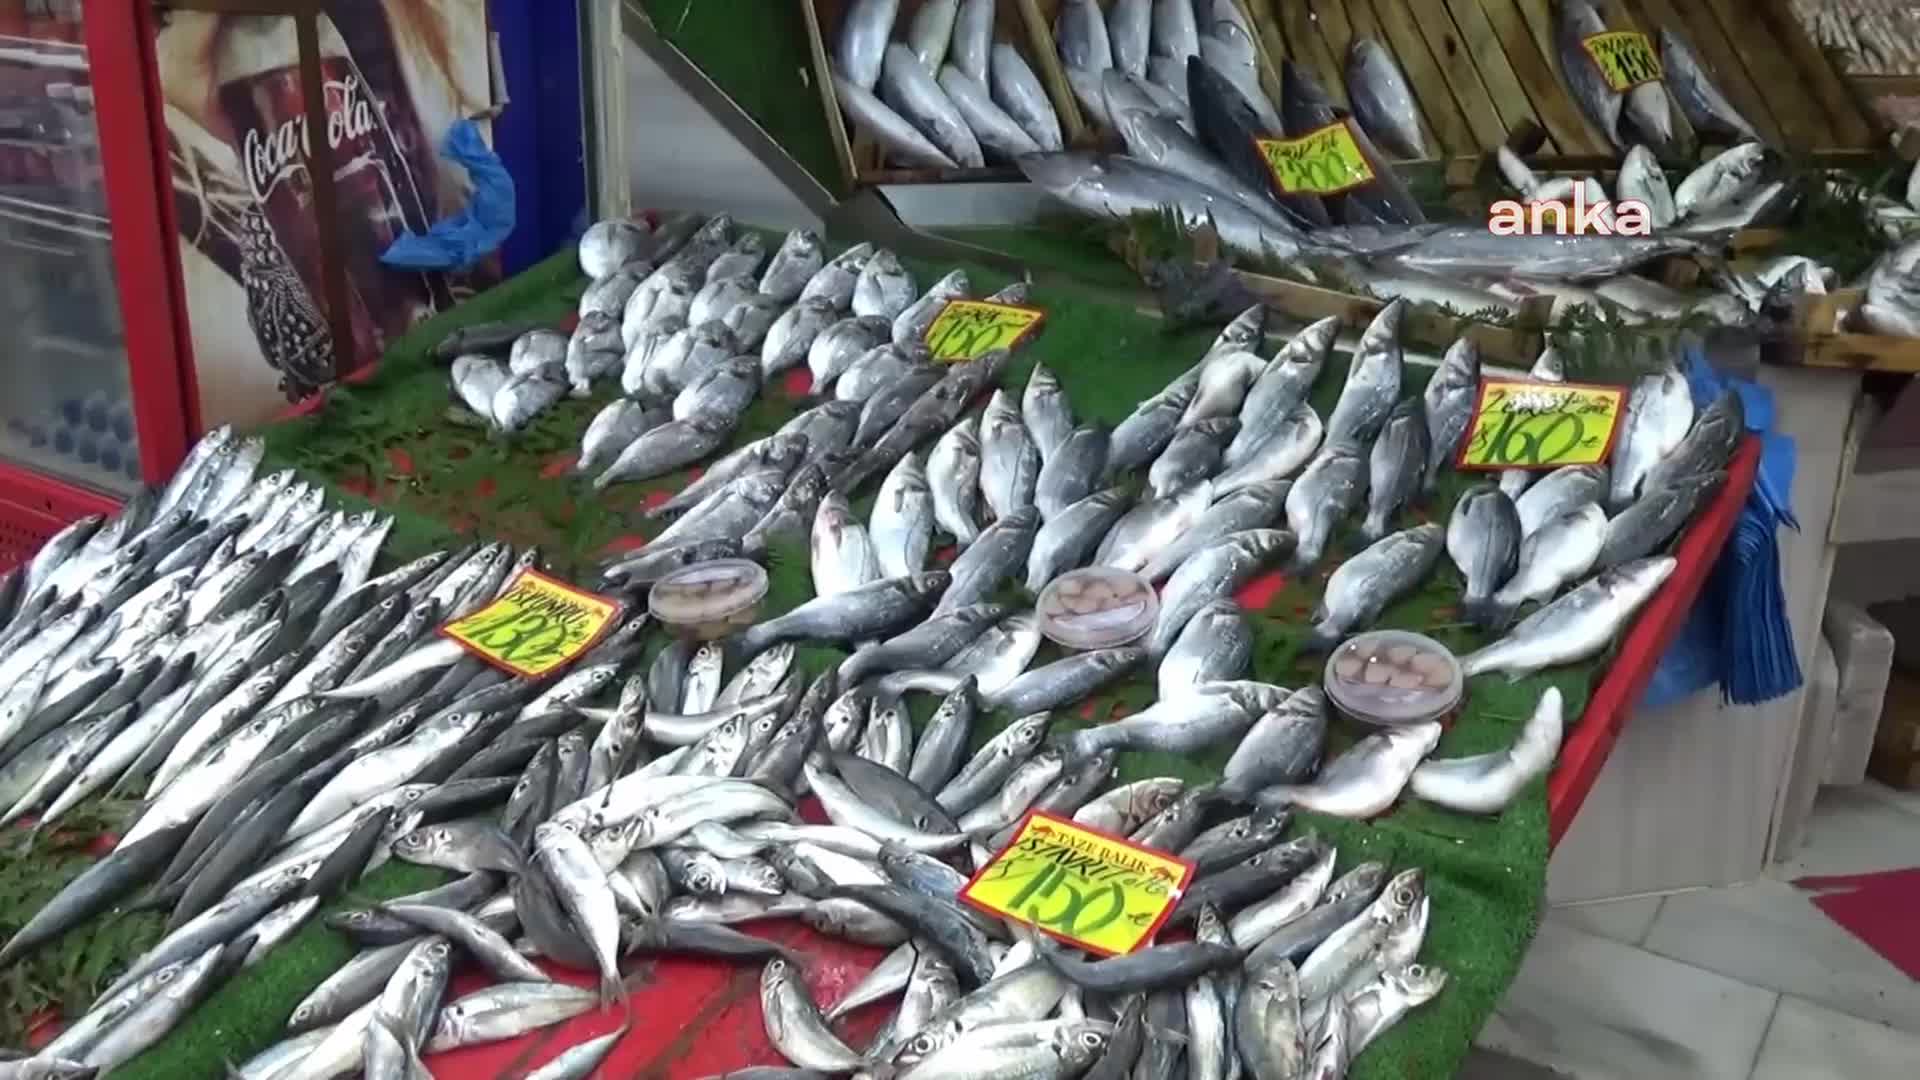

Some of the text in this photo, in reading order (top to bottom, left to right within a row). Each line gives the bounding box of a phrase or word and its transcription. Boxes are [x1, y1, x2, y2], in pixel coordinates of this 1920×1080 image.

[1480, 411, 1585, 464] 160
[1056, 832, 1149, 873] TAZE BALIK
[1007, 862, 1125, 934] 150
